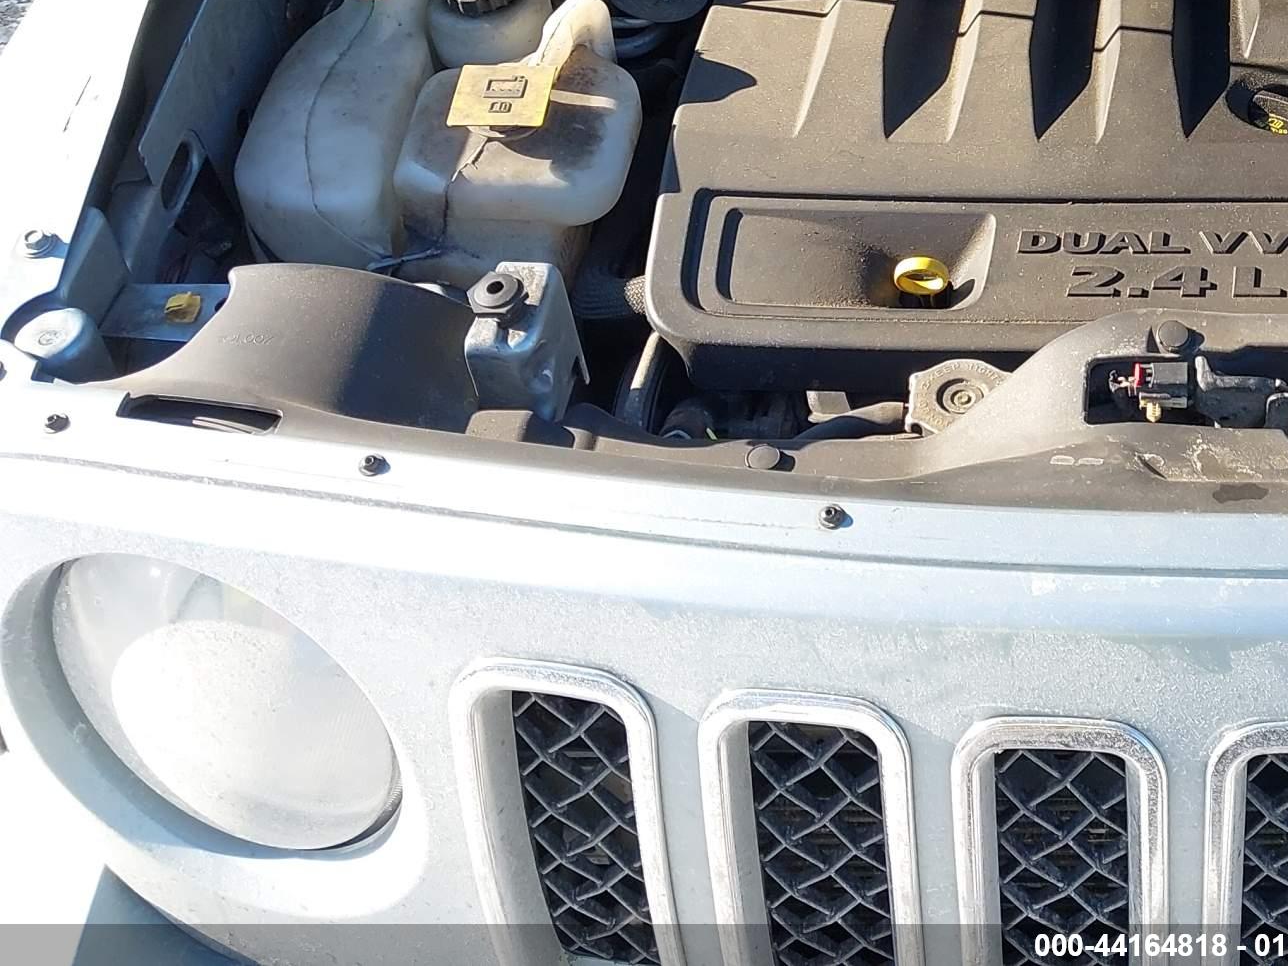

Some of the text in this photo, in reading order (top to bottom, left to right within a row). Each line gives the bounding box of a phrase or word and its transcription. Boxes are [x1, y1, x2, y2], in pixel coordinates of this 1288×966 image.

[1017, 229, 1191, 254] DUAL
[1065, 265, 1288, 298] 2.4 L
